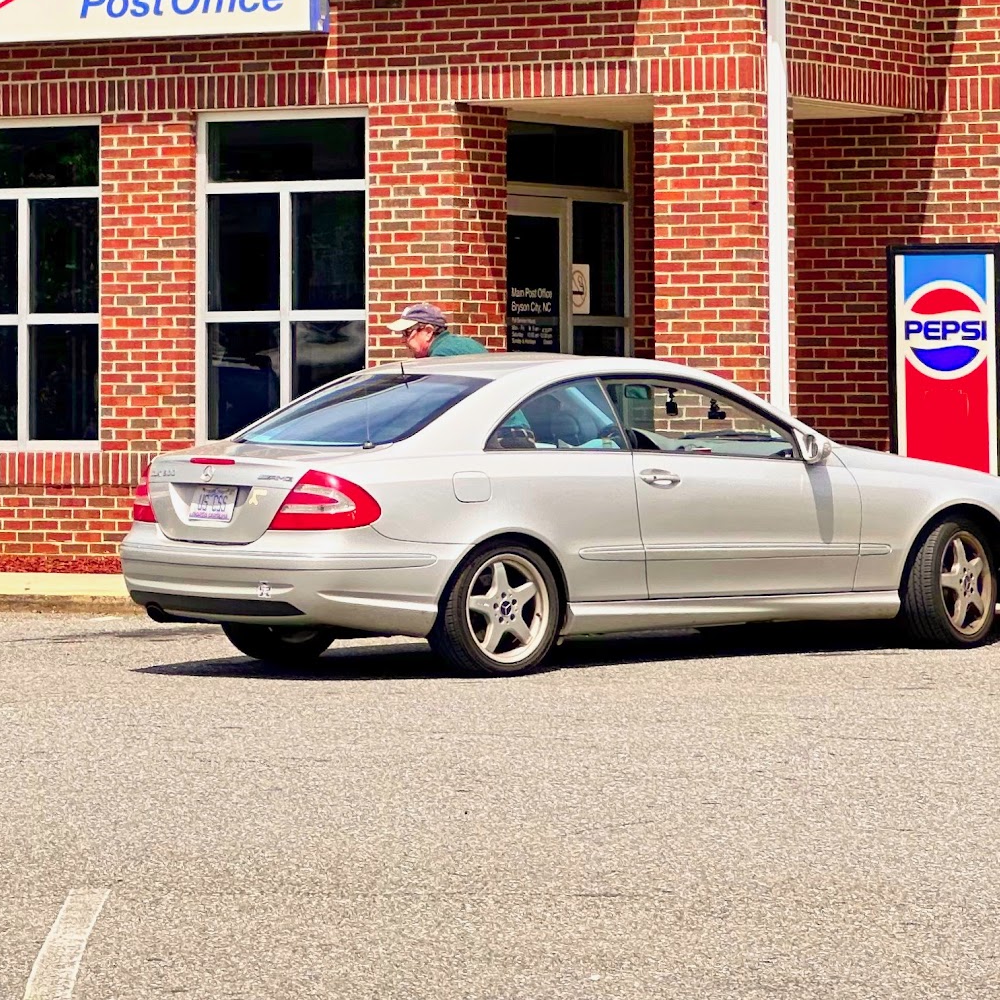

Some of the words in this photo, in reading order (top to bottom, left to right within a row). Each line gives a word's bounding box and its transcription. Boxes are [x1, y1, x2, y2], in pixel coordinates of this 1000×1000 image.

[511, 287, 524, 298] Main
[525, 287, 537, 298] Post
[537, 287, 552, 299] Office
[511, 301, 530, 314] Bryson
[542, 302, 552, 312] NC
[905, 320, 987, 341] PEPSI
